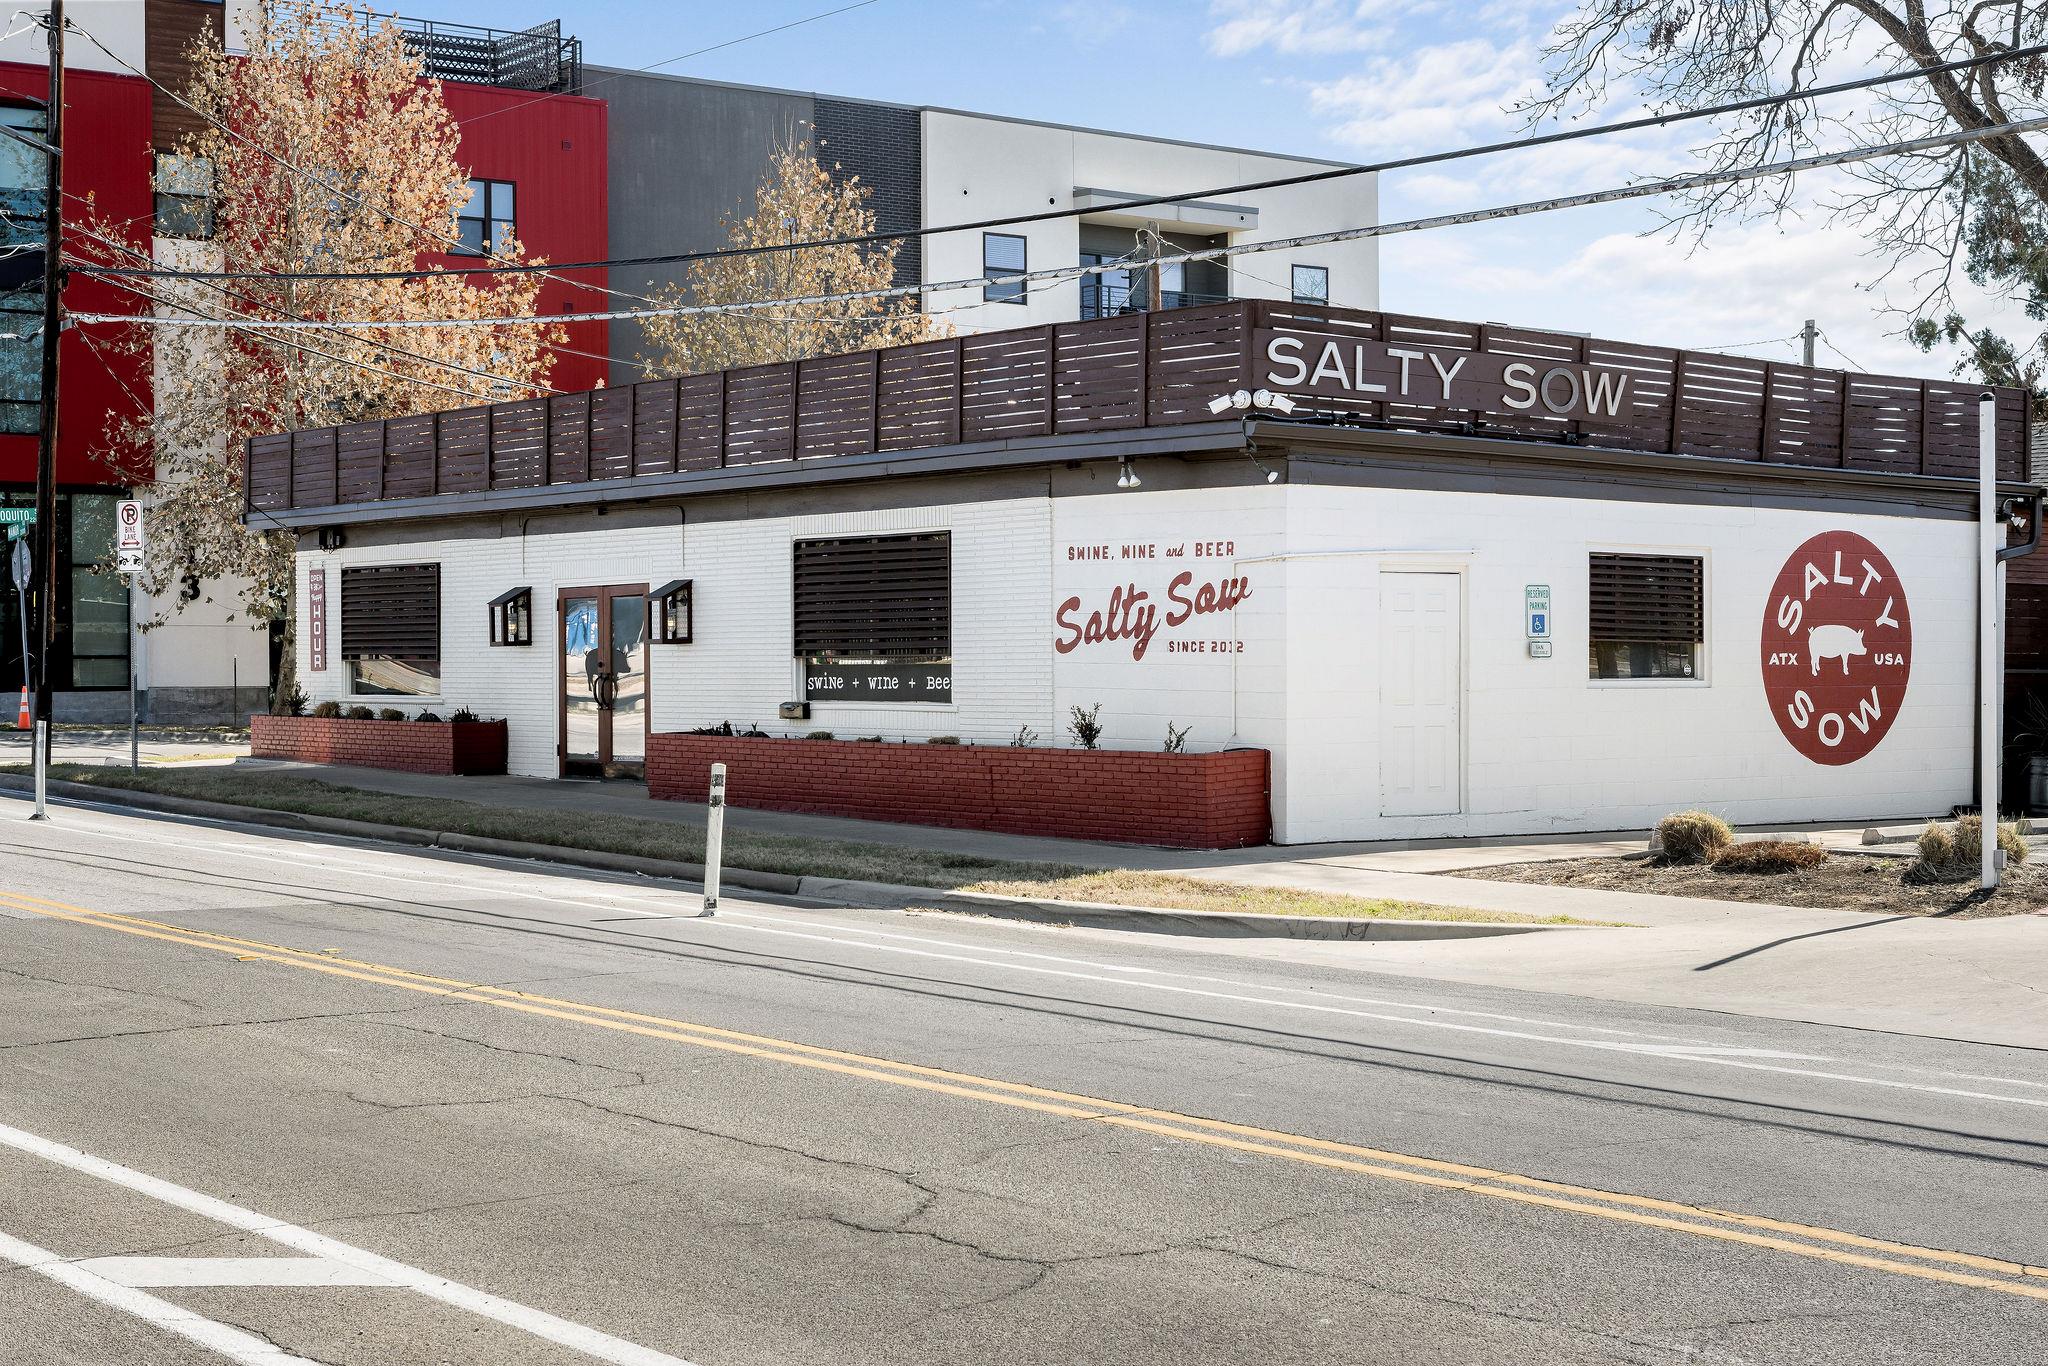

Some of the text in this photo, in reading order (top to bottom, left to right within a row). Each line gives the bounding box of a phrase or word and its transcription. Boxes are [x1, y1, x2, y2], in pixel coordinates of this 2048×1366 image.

[1266, 336, 1628, 416] SALTY SOW
[1068, 541, 1235, 560] SWINE, WINE and BEER
[1527, 589, 1549, 598] RESERVED
[1777, 550, 1899, 635] SALTY
[1529, 601, 1548, 610] PARKING
[1055, 571, 1253, 662] Salty Sow
[313, 604, 322, 668] HOUR
[1169, 641, 1205, 653] SINCE
[1769, 652, 1904, 666] ATX USA
[926, 676, 952, 690] Bee
[1787, 686, 1882, 747] SOW
